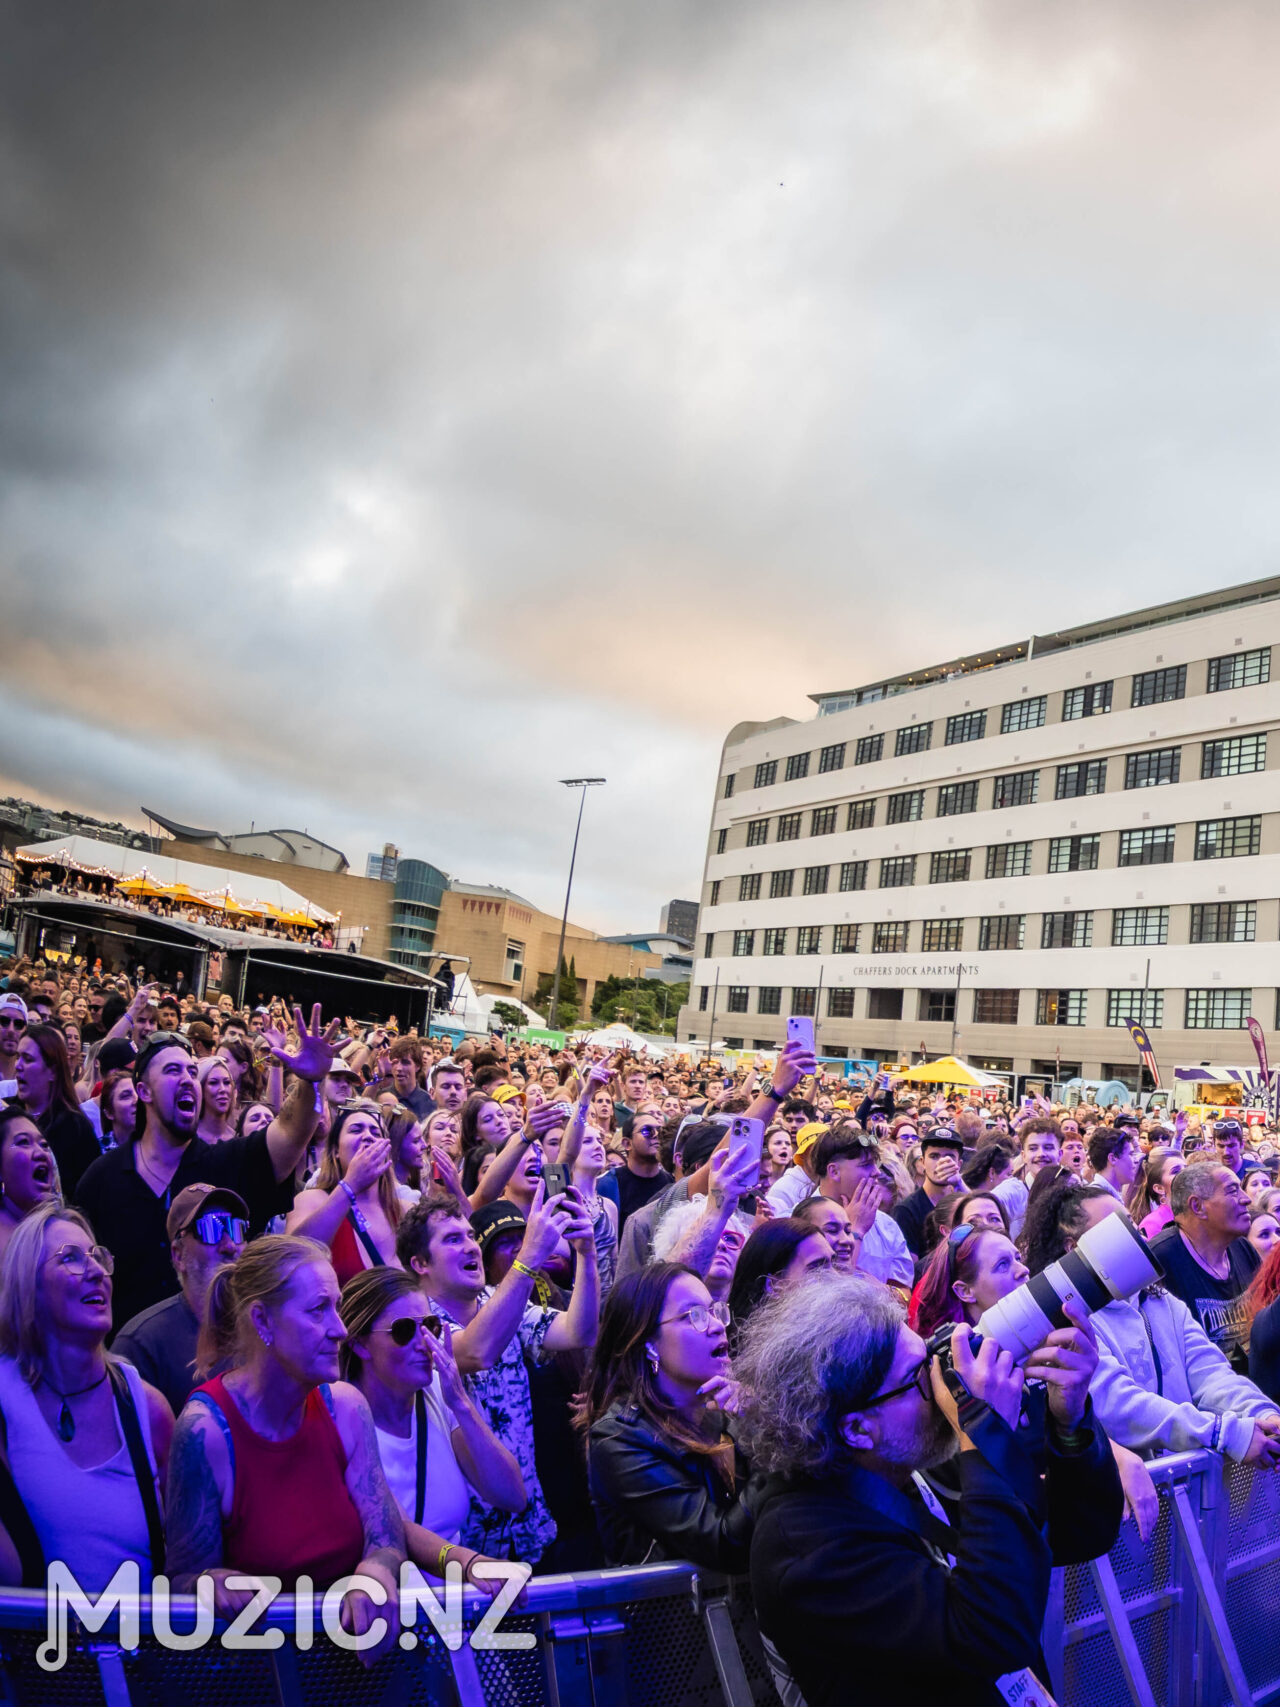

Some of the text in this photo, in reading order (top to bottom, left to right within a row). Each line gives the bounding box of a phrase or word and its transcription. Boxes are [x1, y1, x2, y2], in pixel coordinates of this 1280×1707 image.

[853, 965, 979, 976] CHAFFERS DOCK APARTMENTS
